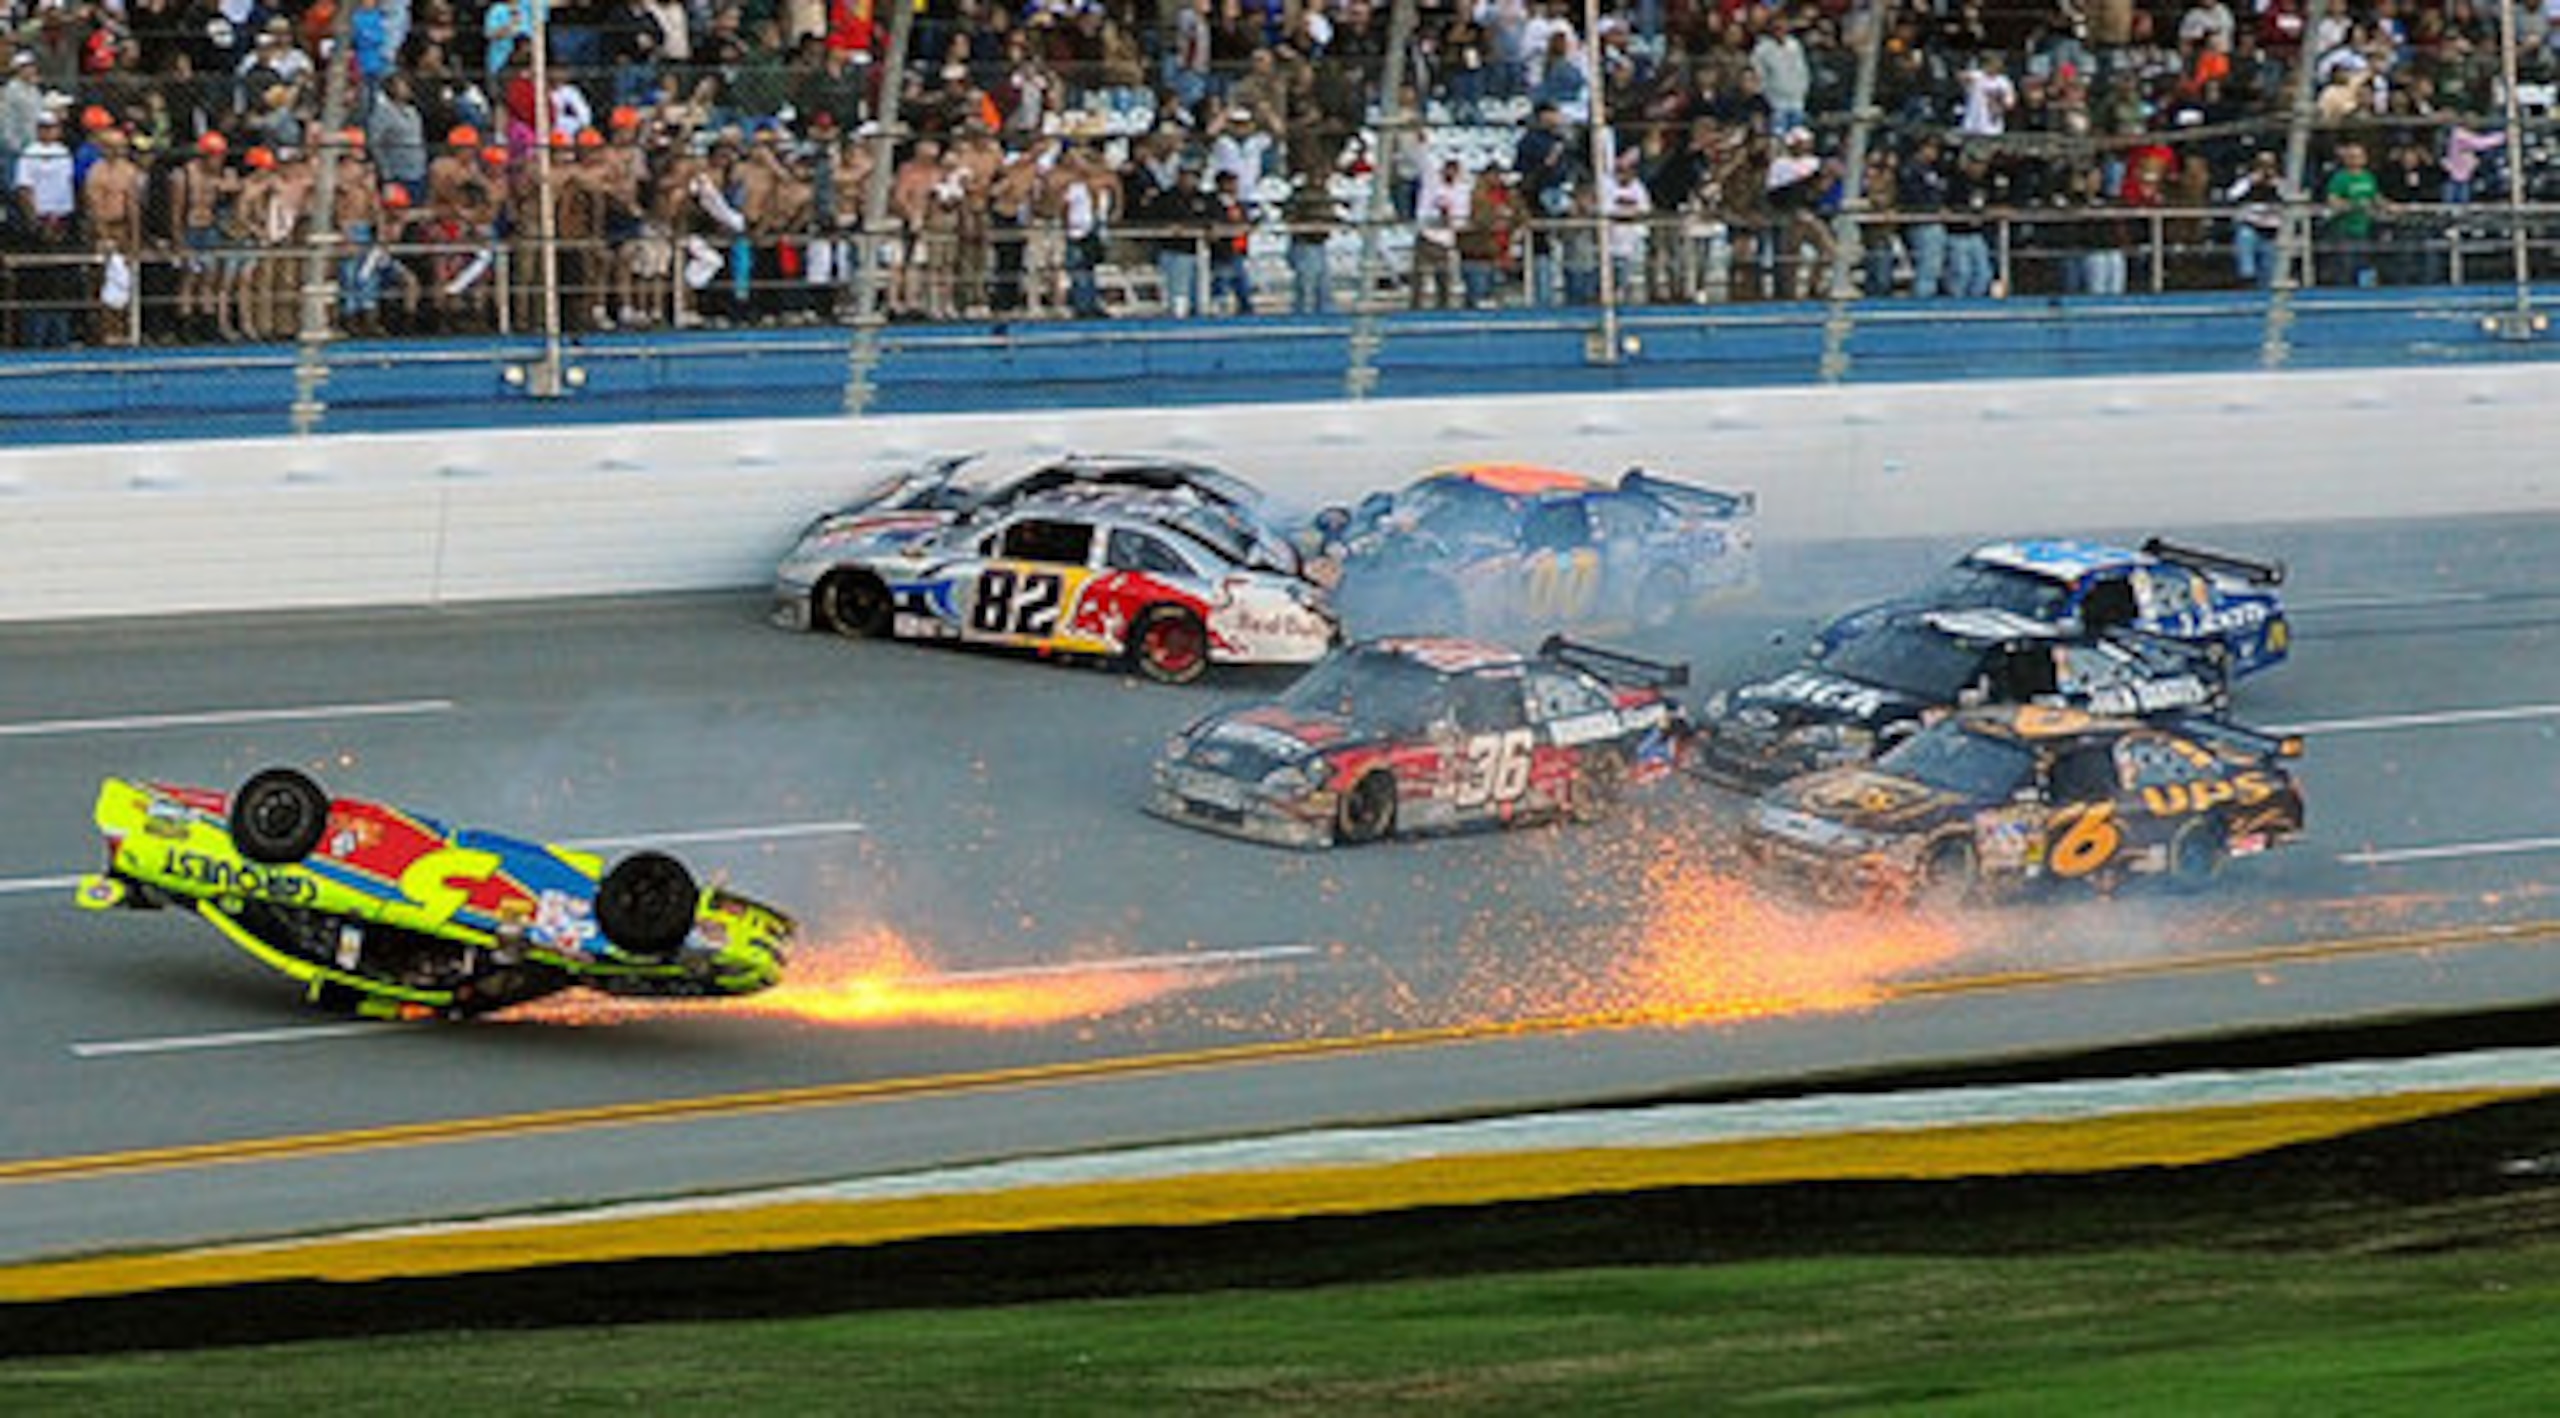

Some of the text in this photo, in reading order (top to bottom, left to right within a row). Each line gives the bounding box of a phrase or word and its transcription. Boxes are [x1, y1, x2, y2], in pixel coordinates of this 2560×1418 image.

[974, 569, 1060, 637] 82
[1457, 728, 1533, 807] 36
[2047, 799, 2120, 877] 6
